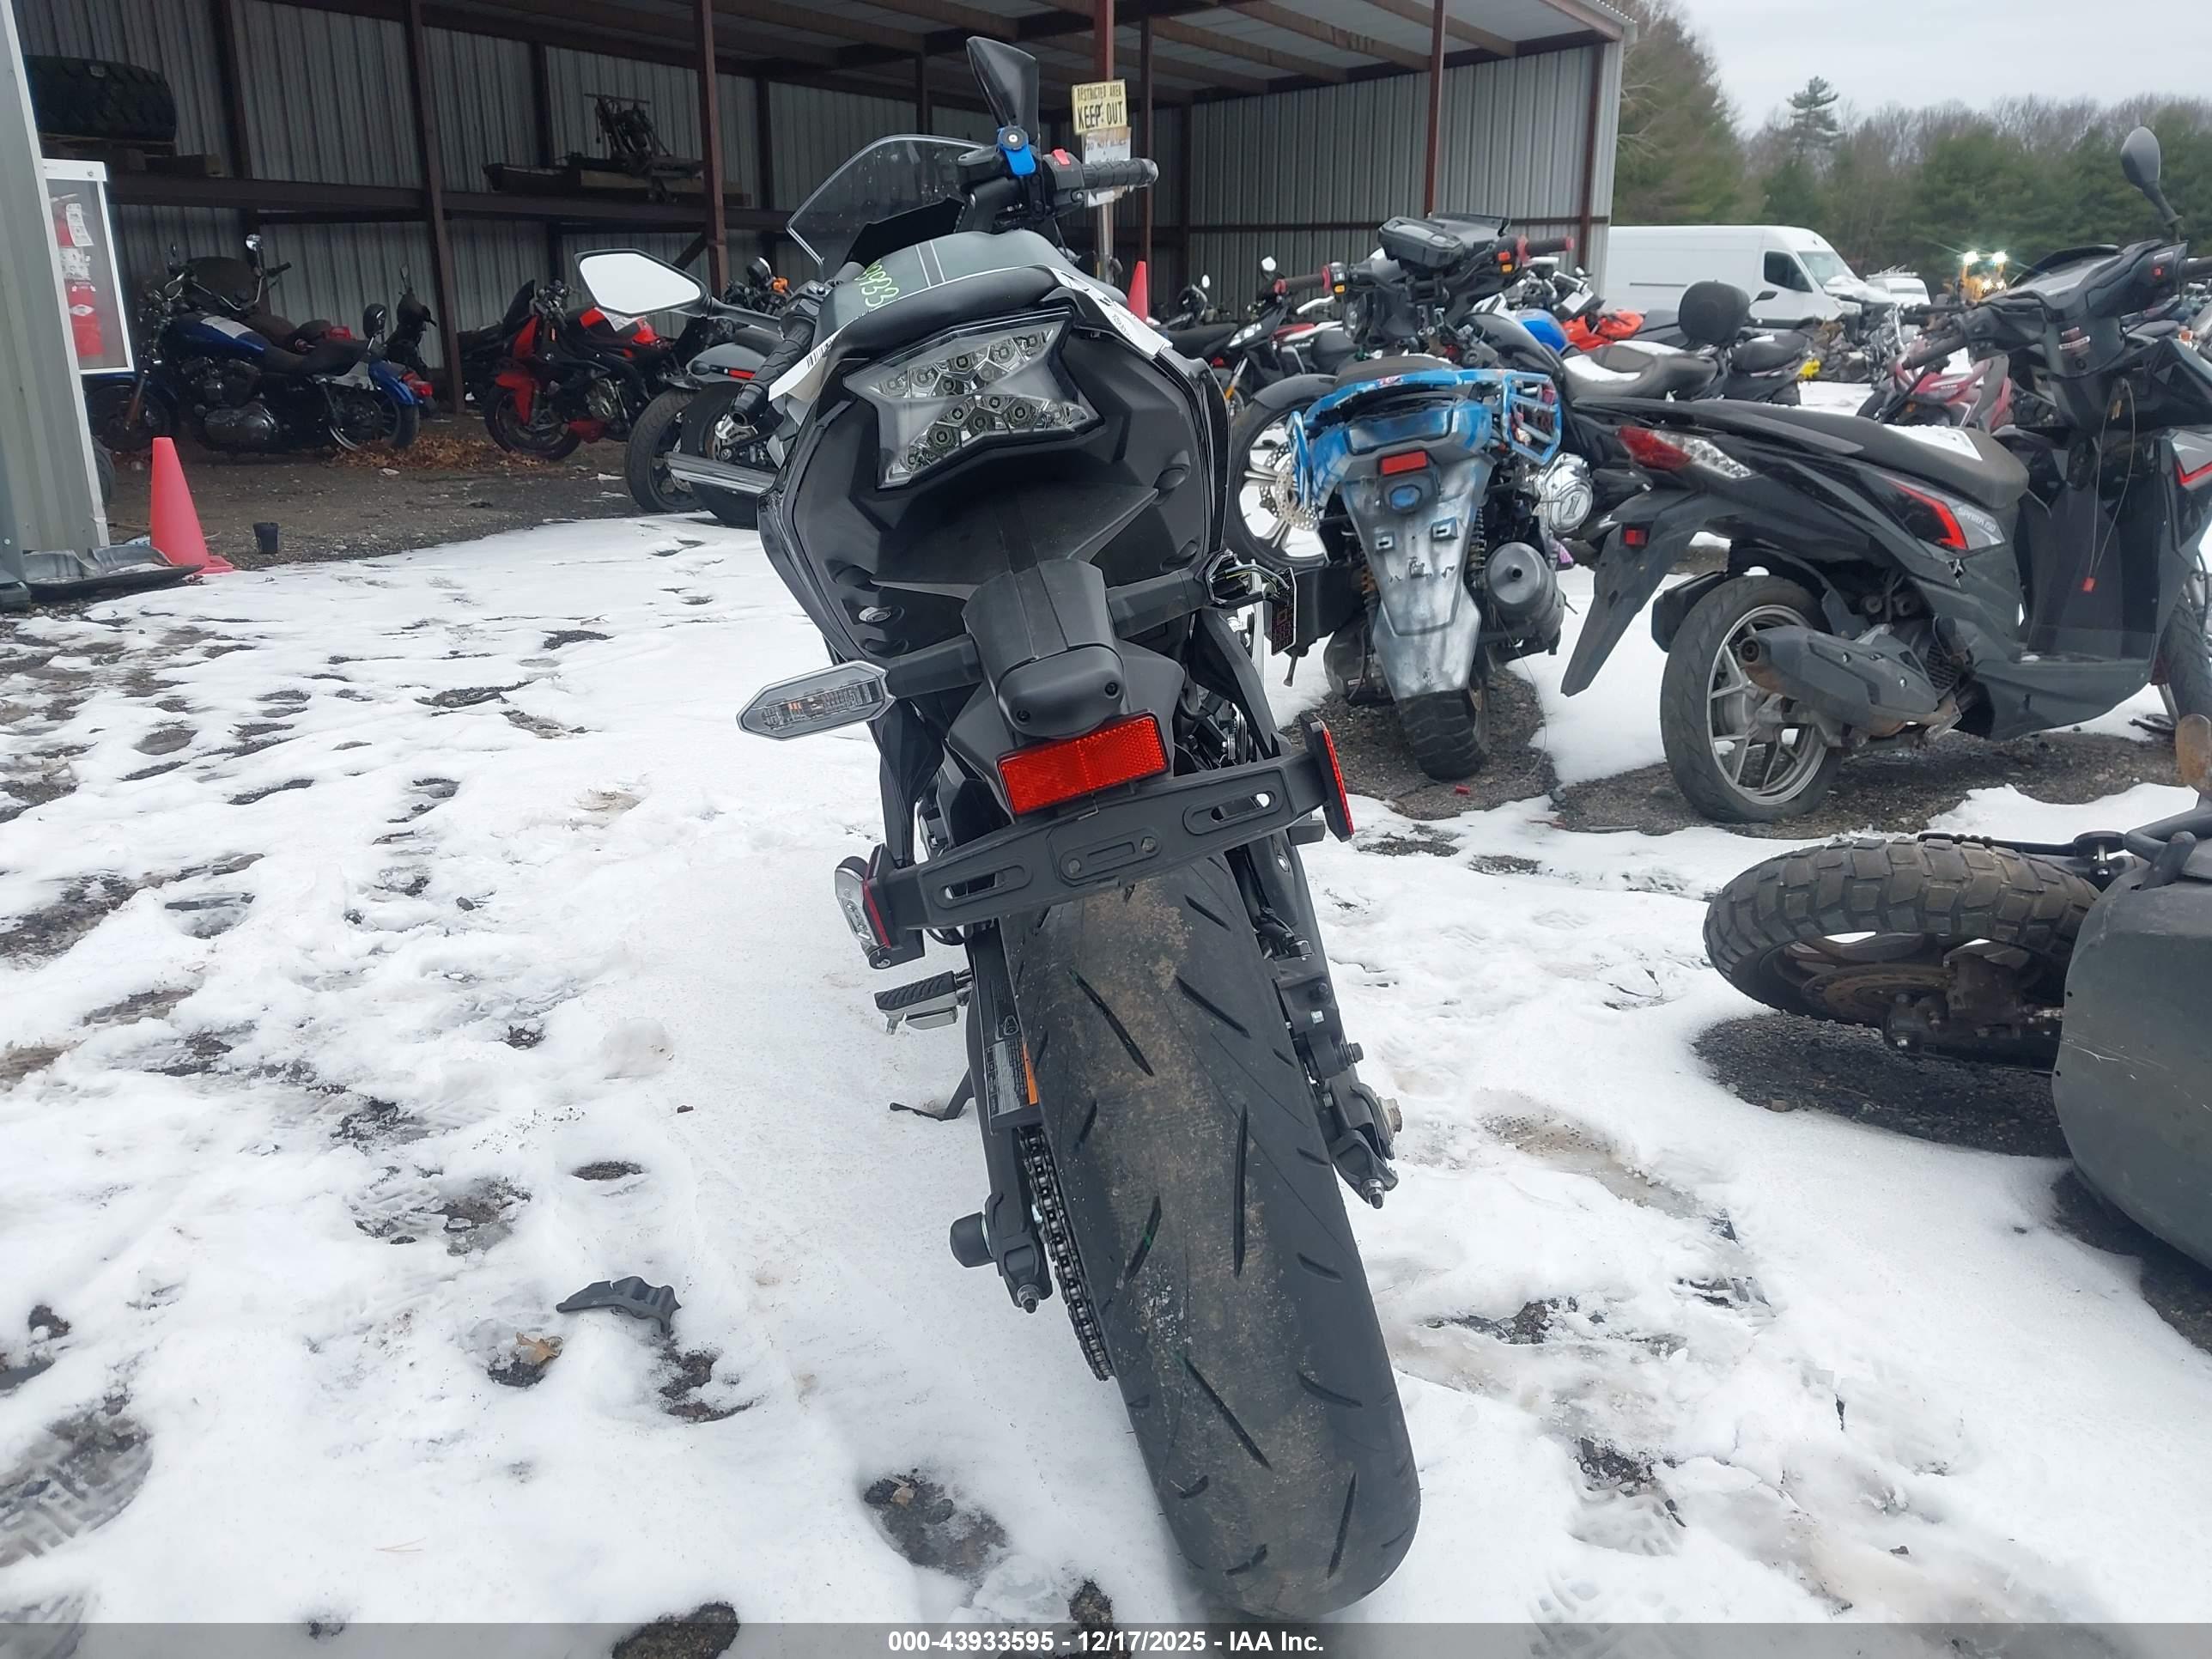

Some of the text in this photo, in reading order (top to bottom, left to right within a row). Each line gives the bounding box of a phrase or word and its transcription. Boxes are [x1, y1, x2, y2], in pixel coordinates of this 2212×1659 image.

[1077, 84, 1122, 101] RESTRICTED AREA
[1078, 101, 1123, 130] KEEP OUT
